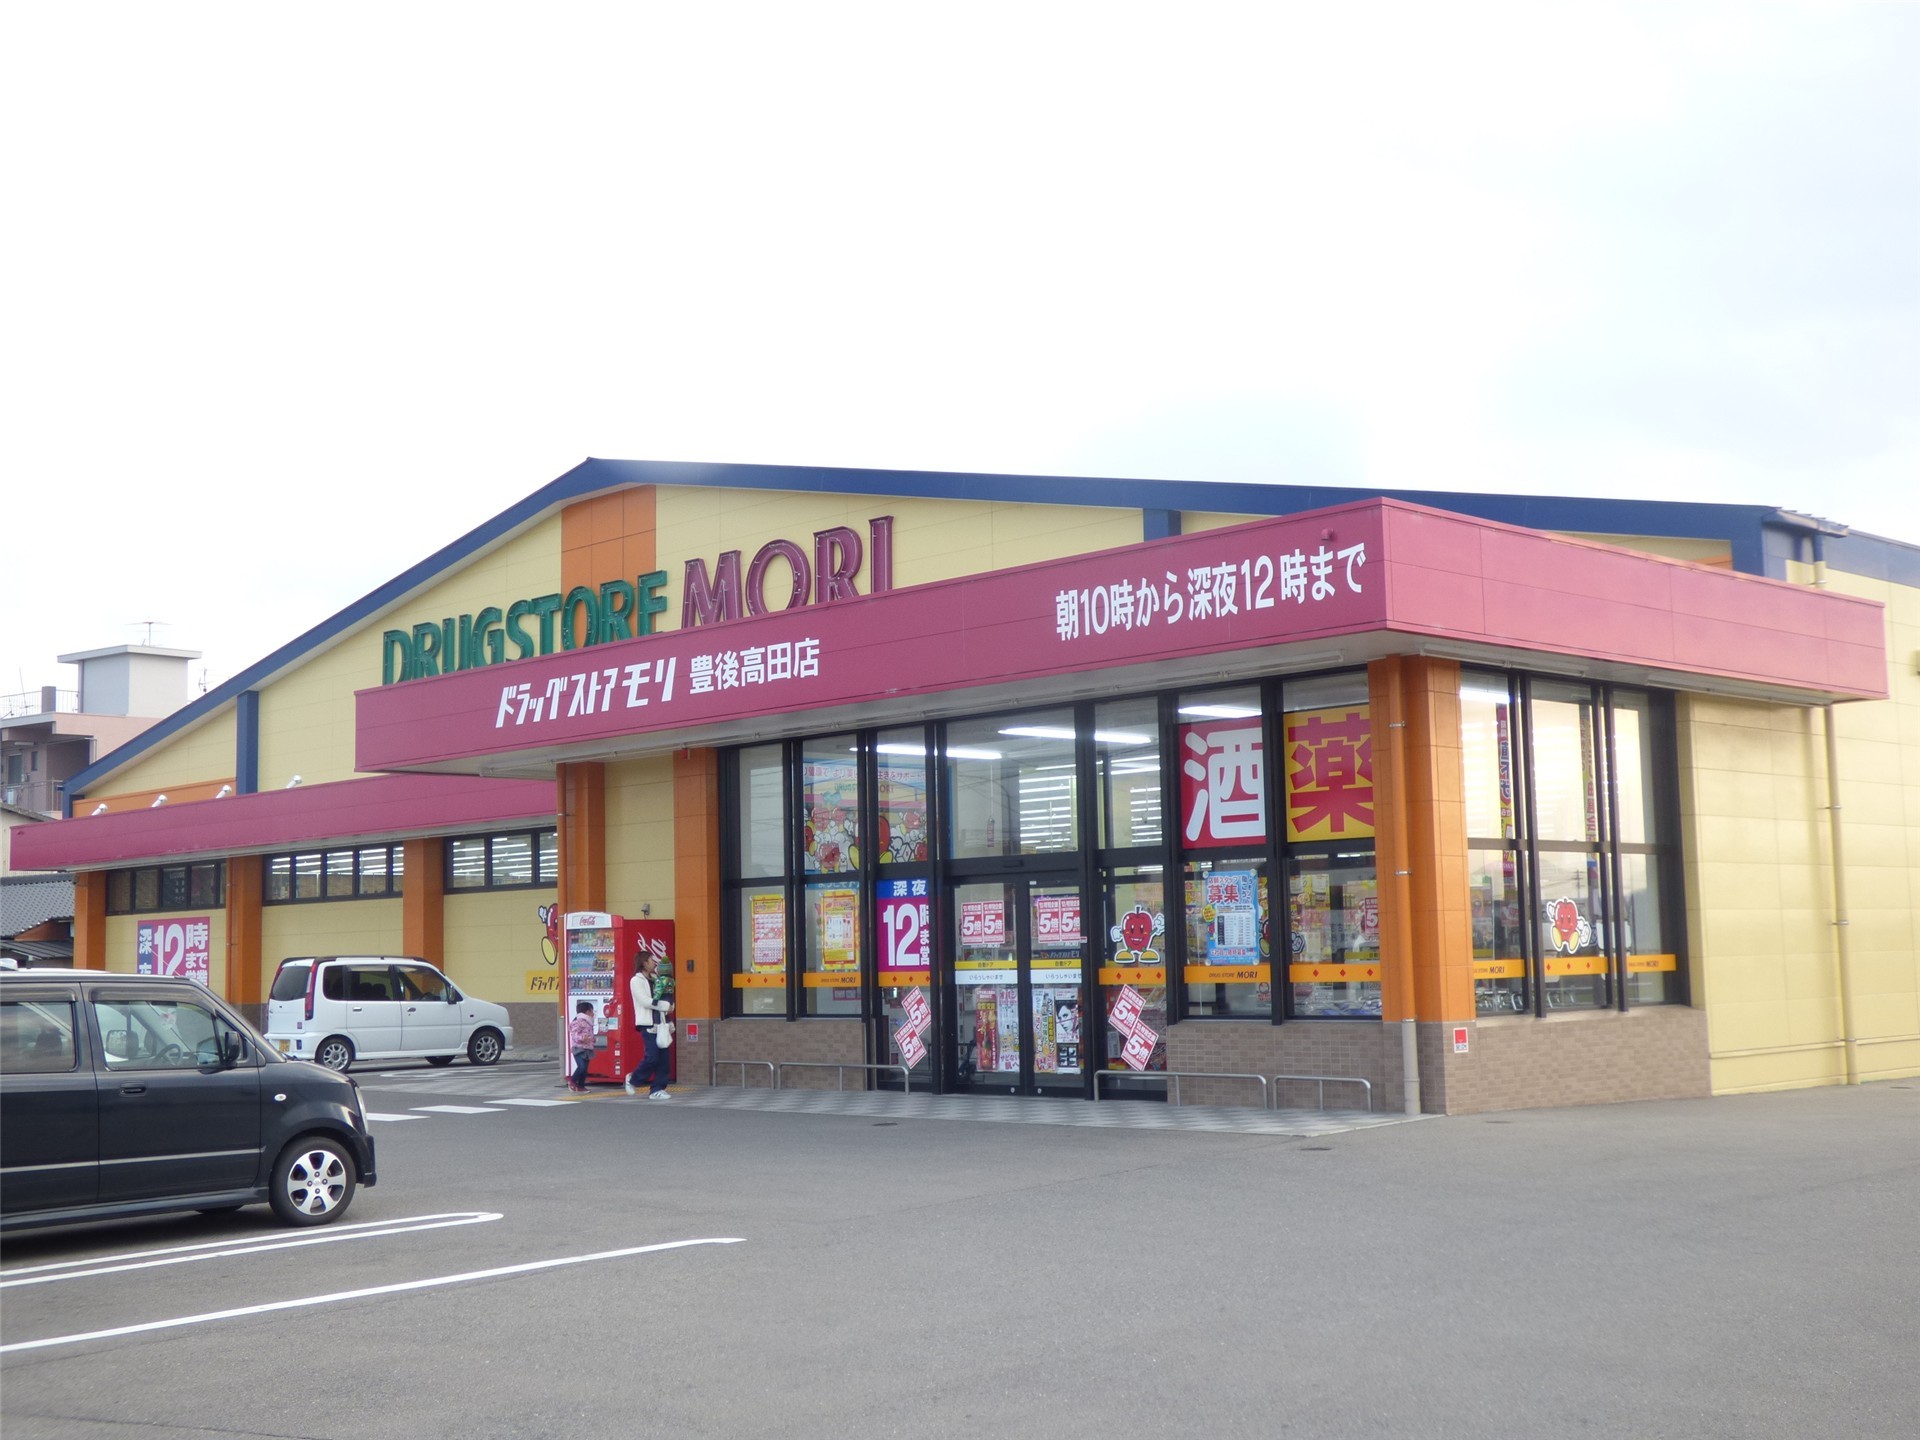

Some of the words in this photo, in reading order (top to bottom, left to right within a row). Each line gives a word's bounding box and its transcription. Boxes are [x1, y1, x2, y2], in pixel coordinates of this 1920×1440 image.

[681, 515, 894, 629] MORI
[1056, 542, 1366, 641] 朝10時から深夜12時まで
[689, 638, 820, 695] 豊後高田店
[1184, 726, 1266, 842] 酒
[1287, 712, 1375, 834] 薬
[893, 880, 927, 896] 深夜
[883, 904, 920, 966] 12
[1237, 970, 1258, 979] MORI
